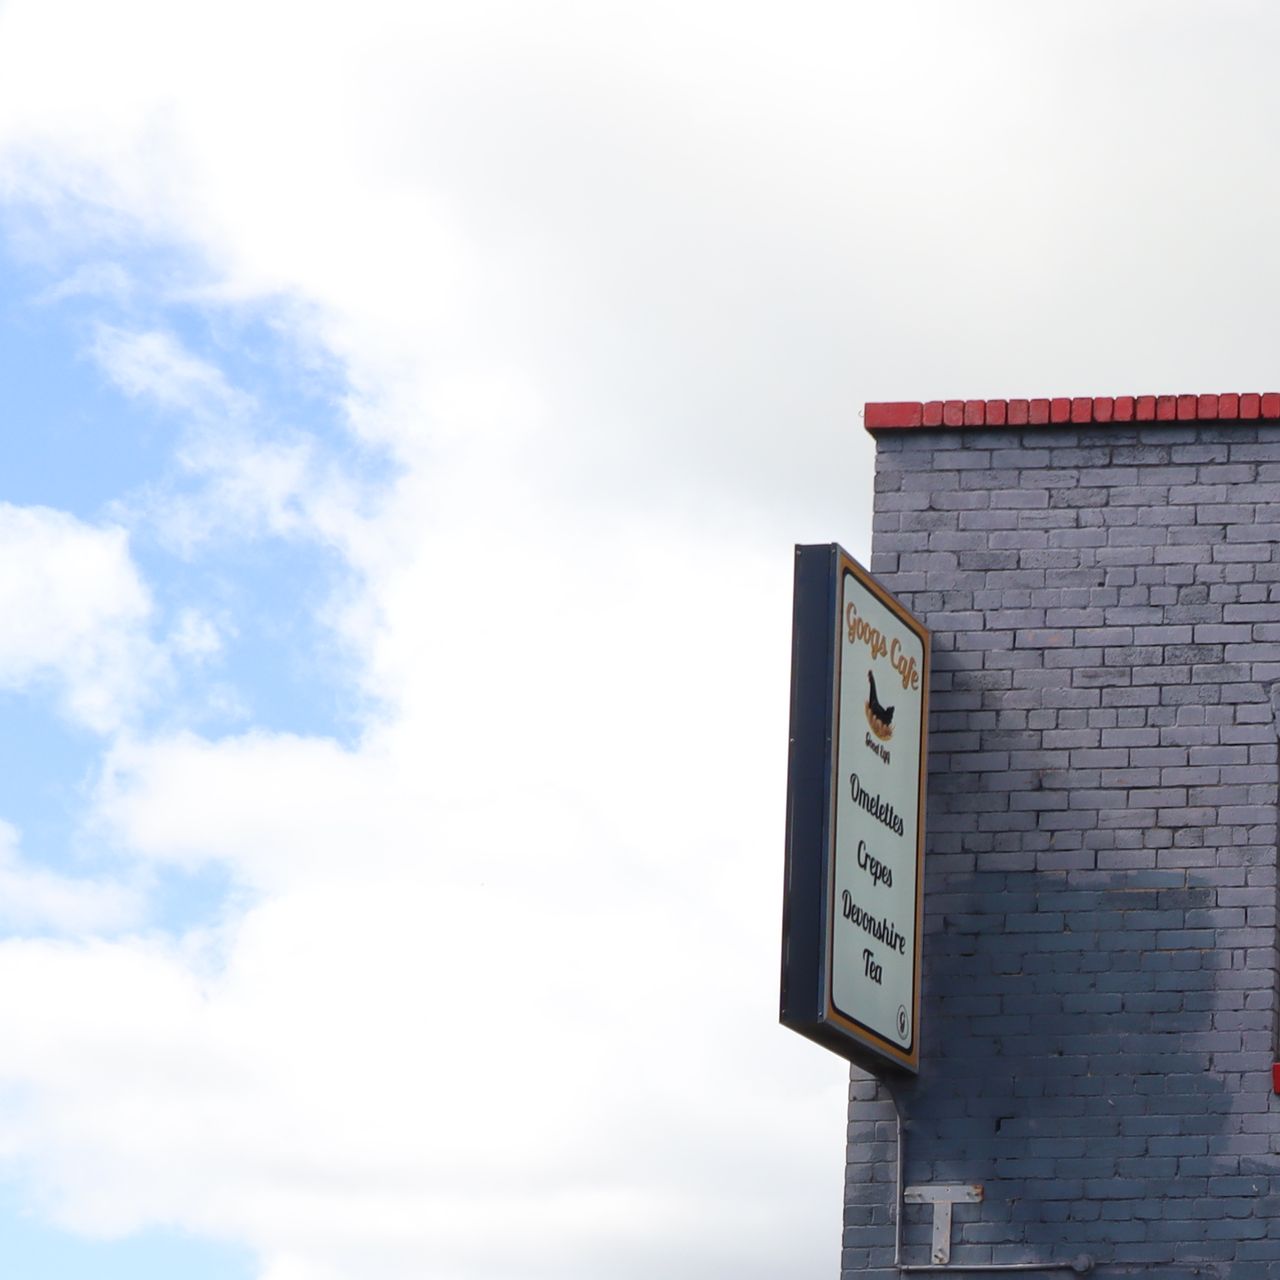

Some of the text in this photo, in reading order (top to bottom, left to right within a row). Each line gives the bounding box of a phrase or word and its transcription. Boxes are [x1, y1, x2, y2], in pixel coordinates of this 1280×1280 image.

[846, 601, 919, 691] Googs Cafe
[865, 732, 879, 755] Good
[850, 773, 904, 837] Omelettes
[857, 840, 893, 888] Crepes
[842, 889, 905, 955] Devonshire
[863, 948, 882, 985] Tea
